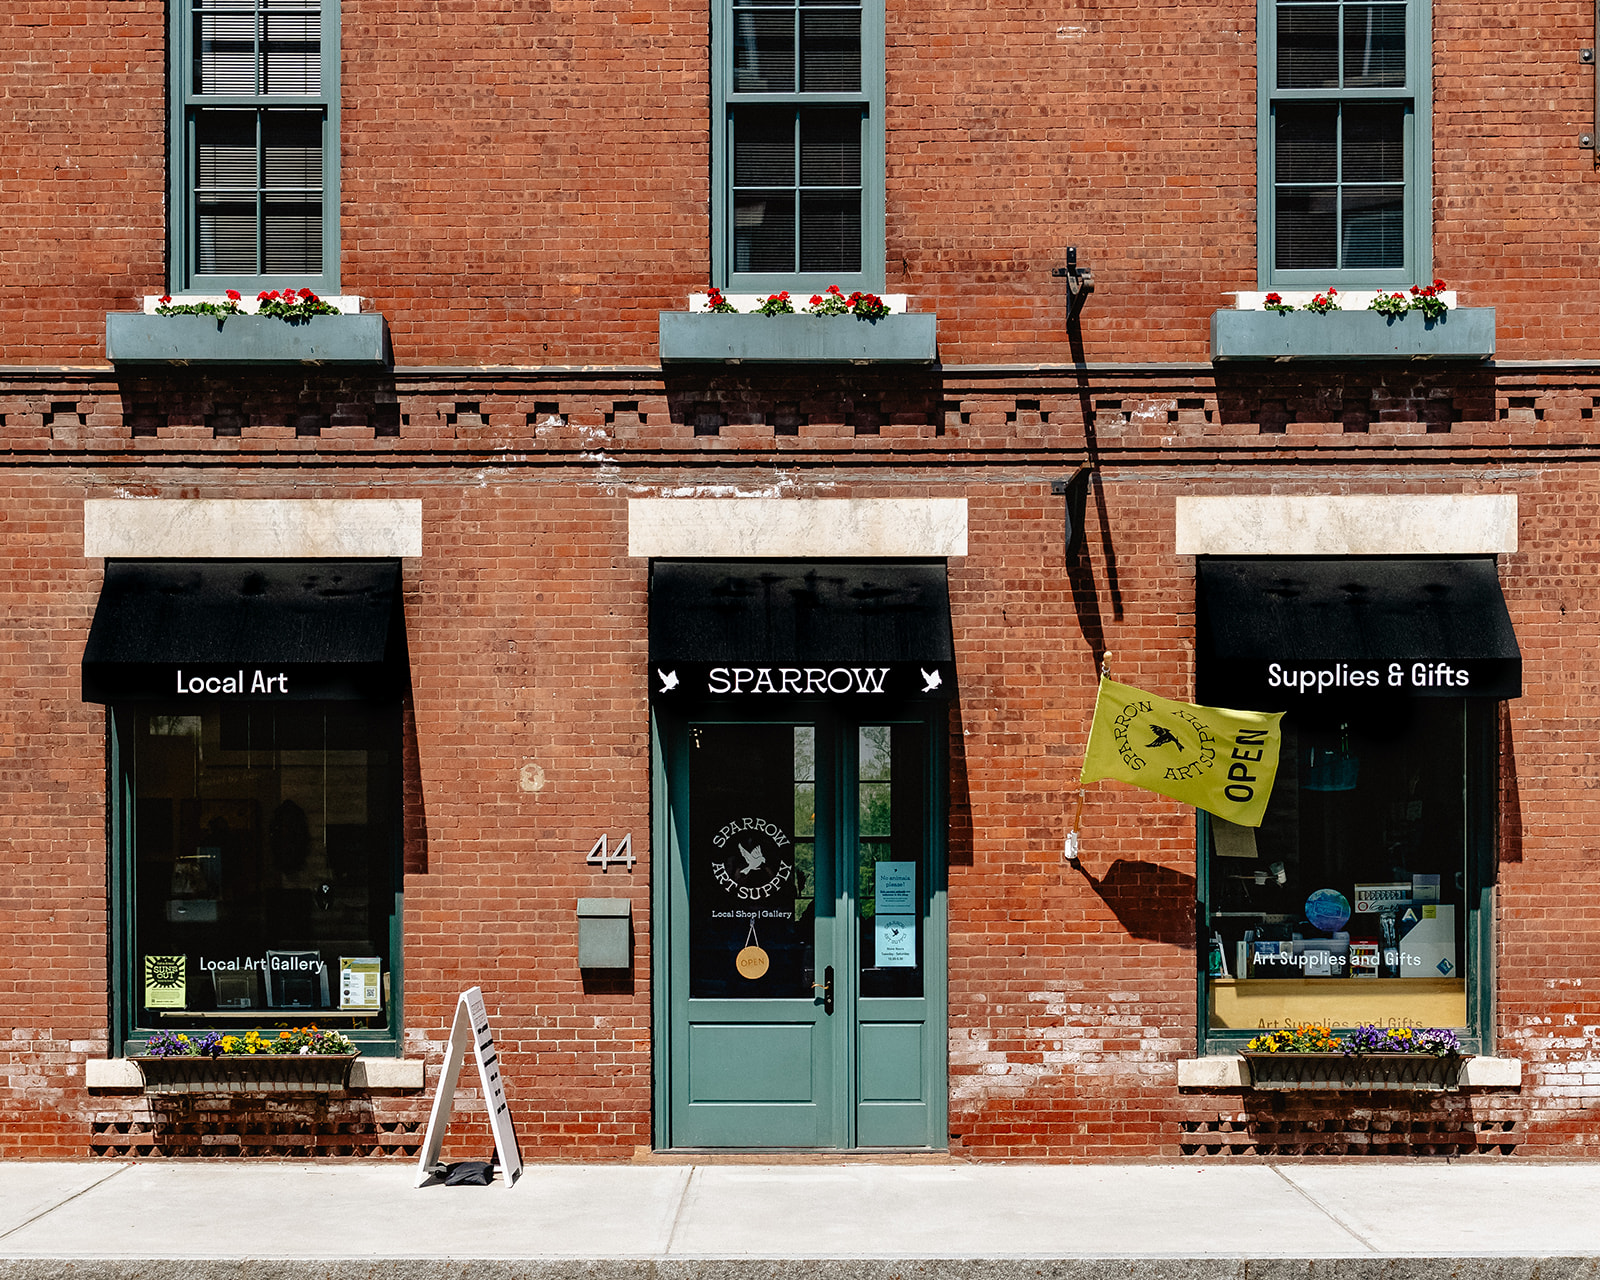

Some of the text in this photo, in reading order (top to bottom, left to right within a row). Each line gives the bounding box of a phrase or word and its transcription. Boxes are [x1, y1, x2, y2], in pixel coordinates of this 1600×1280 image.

[177, 670, 288, 694] Local Art
[708, 667, 891, 694] SPARROW
[1268, 662, 1470, 694] Supplies & Gifts
[1114, 701, 1154, 771] SPARROW
[1163, 710, 1216, 781] ART SUPPLY
[1224, 728, 1269, 803] OPEN
[712, 817, 791, 848] SPARROW
[586, 833, 637, 870] 44
[711, 860, 793, 900] ART SUPPLY
[712, 910, 734, 918] Local
[735, 910, 758, 919] Shop
[761, 910, 792, 919] Gallery
[200, 956, 324, 975] Local Art Gallery
[740, 957, 766, 968] OPEN
[1253, 951, 1421, 969] Art Supplies and Gifts
